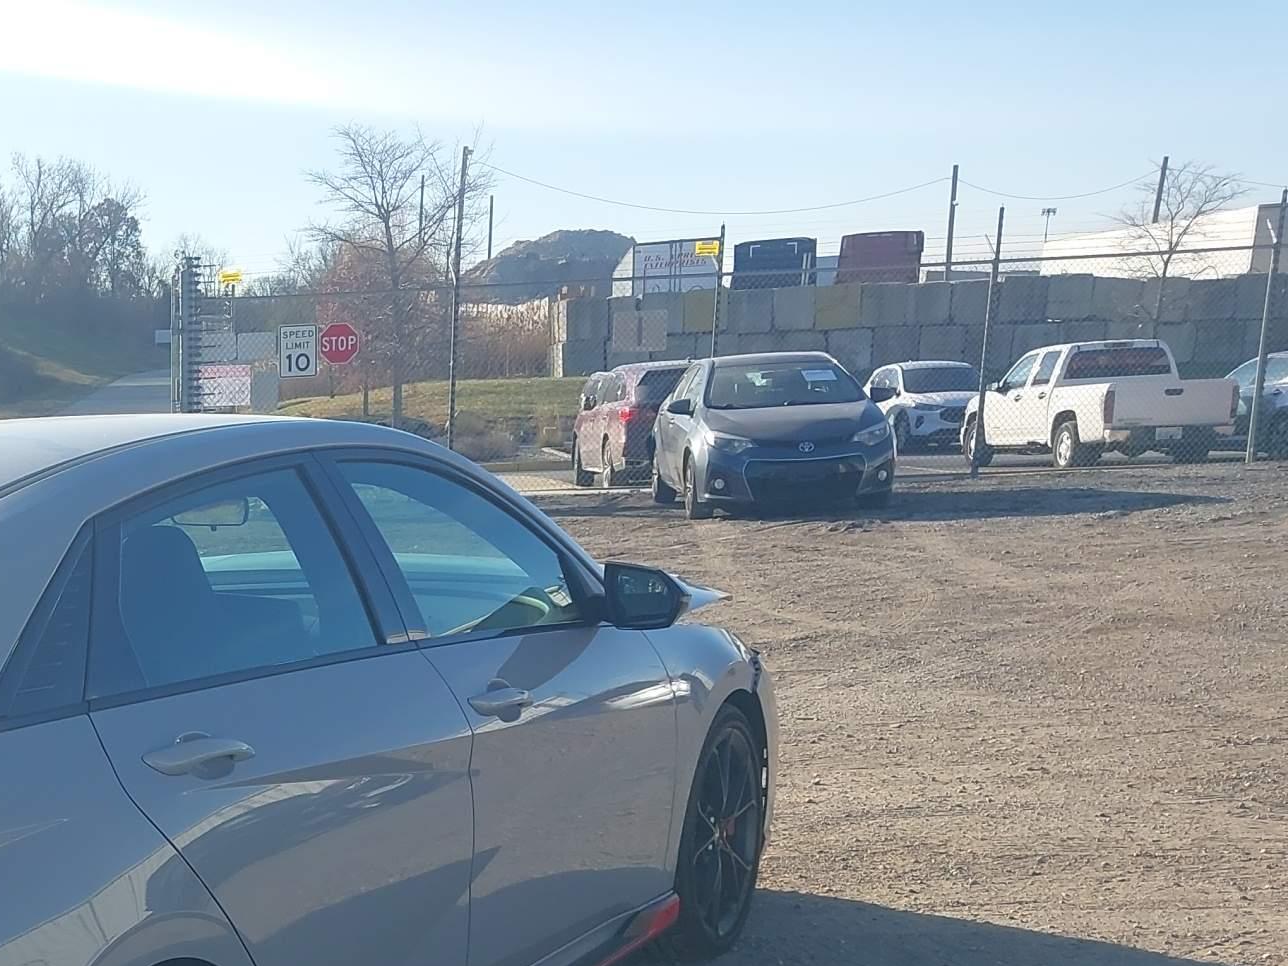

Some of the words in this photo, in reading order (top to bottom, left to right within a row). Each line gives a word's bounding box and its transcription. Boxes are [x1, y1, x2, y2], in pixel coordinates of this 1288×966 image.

[282, 329, 314, 339] SPEED
[285, 341, 312, 350] LIMIT
[322, 335, 357, 352] STOP
[285, 352, 311, 372] 10
